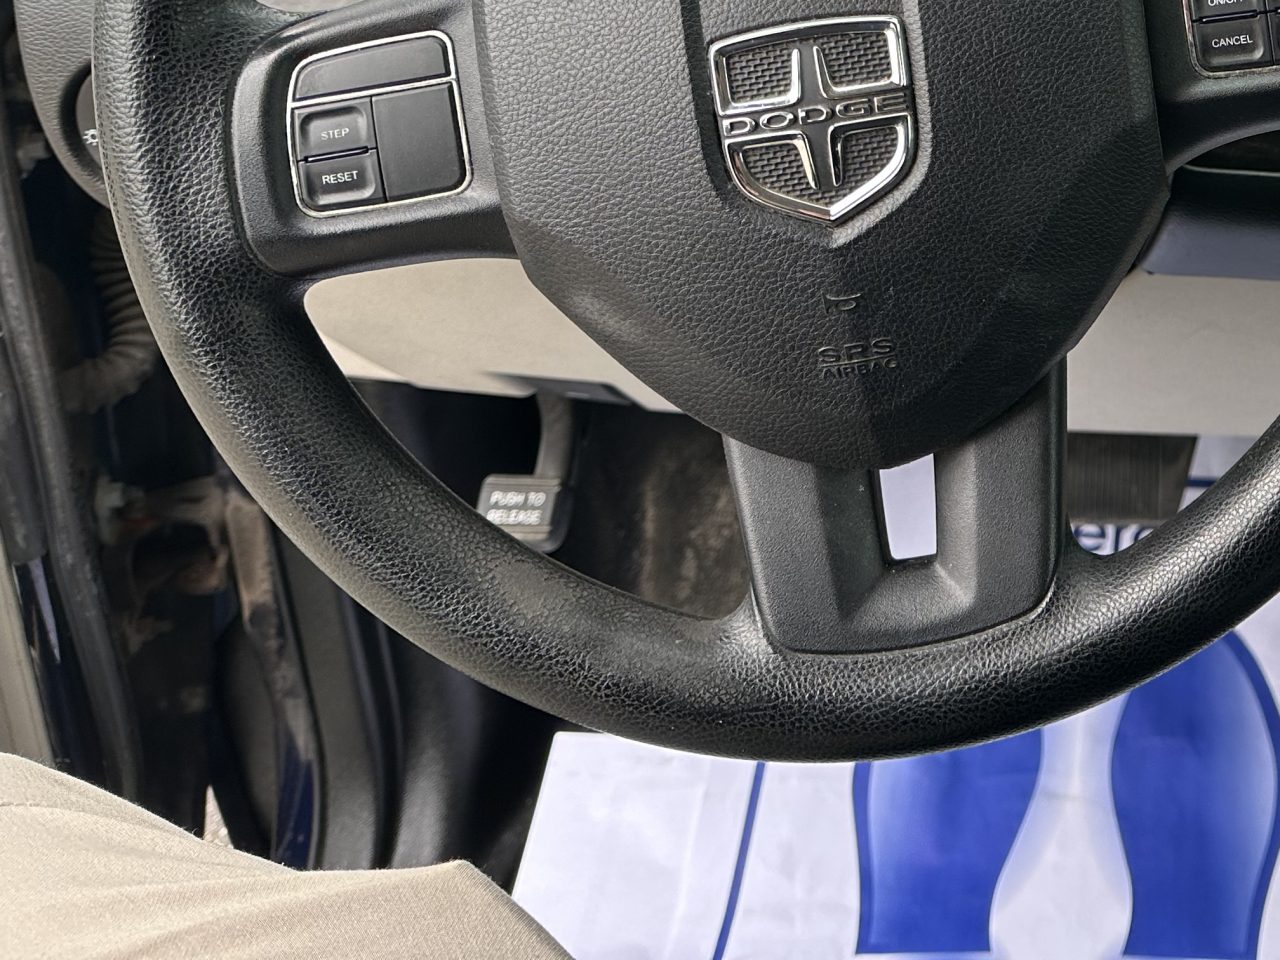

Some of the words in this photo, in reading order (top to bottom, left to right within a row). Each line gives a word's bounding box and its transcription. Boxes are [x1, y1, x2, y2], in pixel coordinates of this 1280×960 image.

[1211, 35, 1253, 48] CANCEL
[723, 92, 909, 137] DODGE
[321, 127, 350, 140] STEP
[322, 170, 359, 185] RESET
[821, 357, 897, 379] AIRBAG
[489, 491, 526, 507] PUSH
[527, 492, 546, 507] TO
[486, 509, 542, 525] RELEASE
